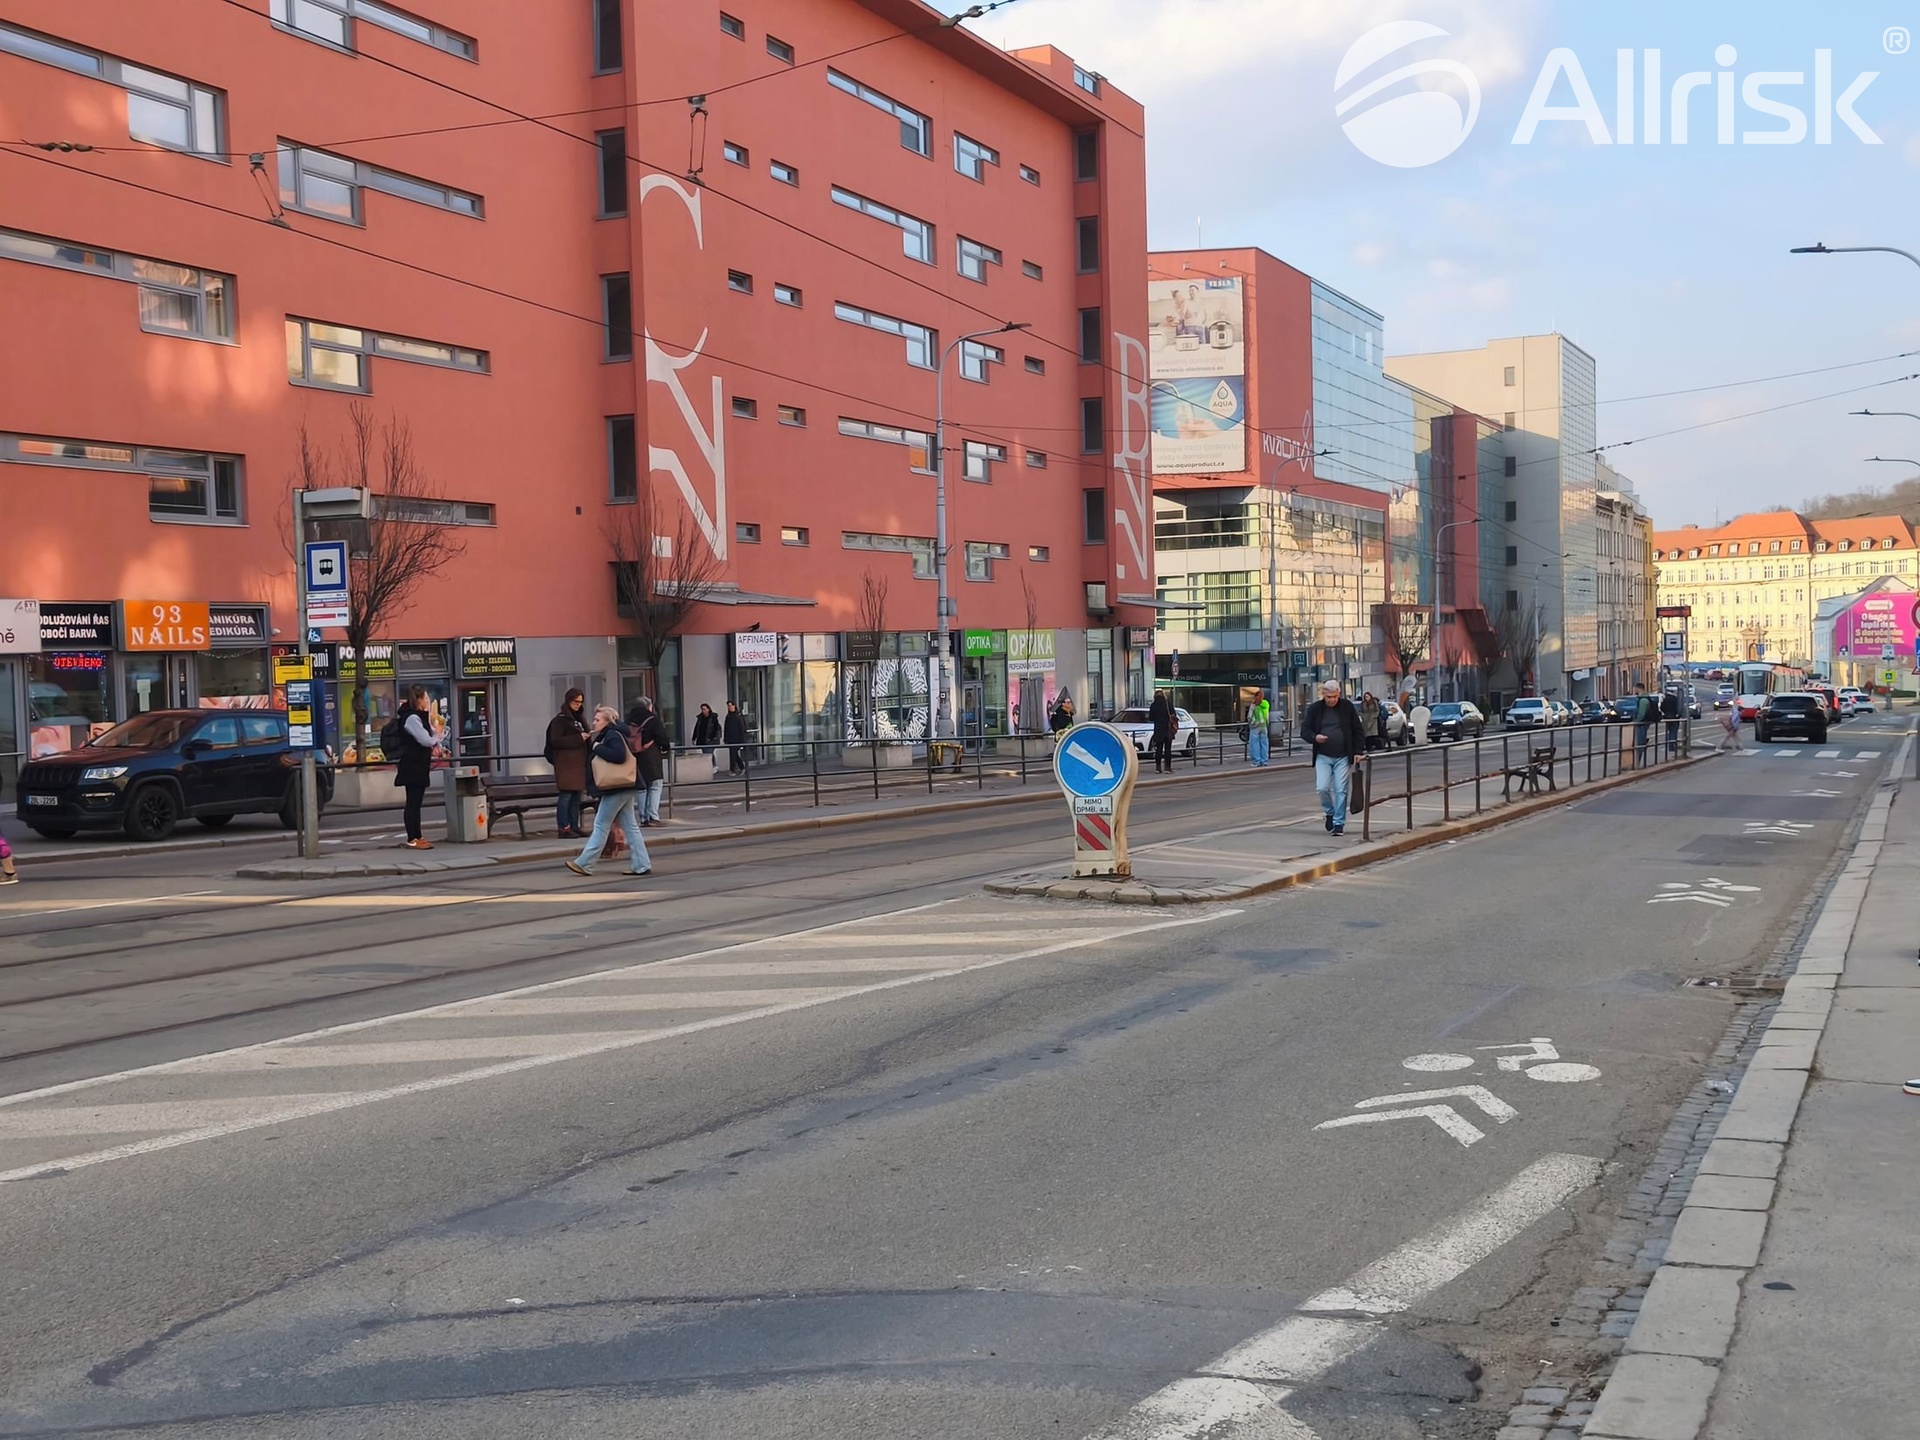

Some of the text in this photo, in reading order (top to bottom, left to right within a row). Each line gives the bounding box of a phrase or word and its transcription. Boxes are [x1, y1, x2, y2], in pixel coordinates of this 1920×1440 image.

[1208, 279, 1232, 287] TESLA
[209, 613, 255, 624] ANIKÚRA
[41, 627, 97, 639] OBOČÍ BARVA
[131, 626, 205, 645] NAILS
[209, 625, 256, 636] EDIKÚRA
[738, 635, 775, 644] AFFINAGE
[966, 635, 991, 650] OPTIKA
[339, 645, 392, 660] POAVINY
[463, 641, 514, 655] POTRAVINY
